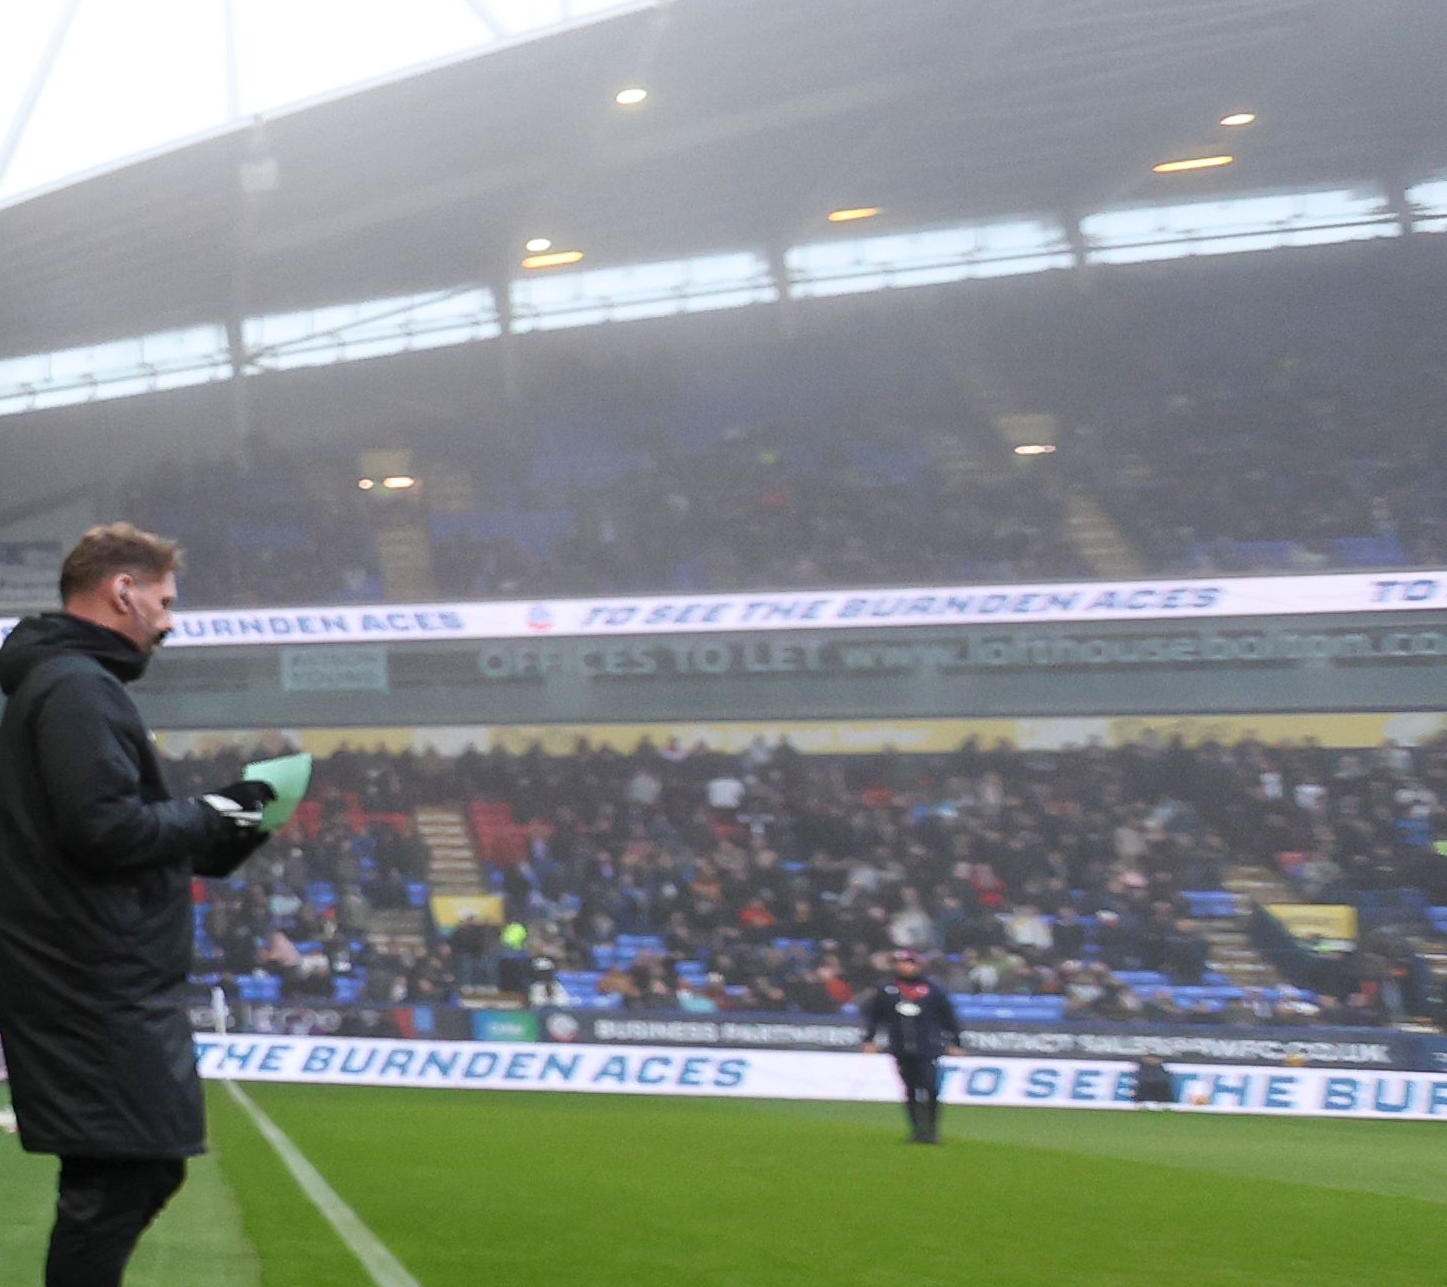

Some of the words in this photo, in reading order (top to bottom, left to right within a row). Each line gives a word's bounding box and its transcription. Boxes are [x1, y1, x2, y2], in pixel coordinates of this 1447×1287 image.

[581, 607, 640, 629] TO
[643, 603, 734, 625] SEE
[742, 599, 832, 621] THE
[836, 592, 1085, 618] BURNDEN
[1087, 587, 1224, 611] ACES
[1369, 579, 1438, 603] TO
[171, 614, 349, 640] URNDEN
[362, 610, 465, 631] ACES
[195, 1042, 289, 1072] THE
[301, 1045, 581, 1083] BURNDEN
[593, 1055, 751, 1088] ACES
[1024, 1067, 1138, 1104] SEE
[1170, 1072, 1299, 1109] THE
